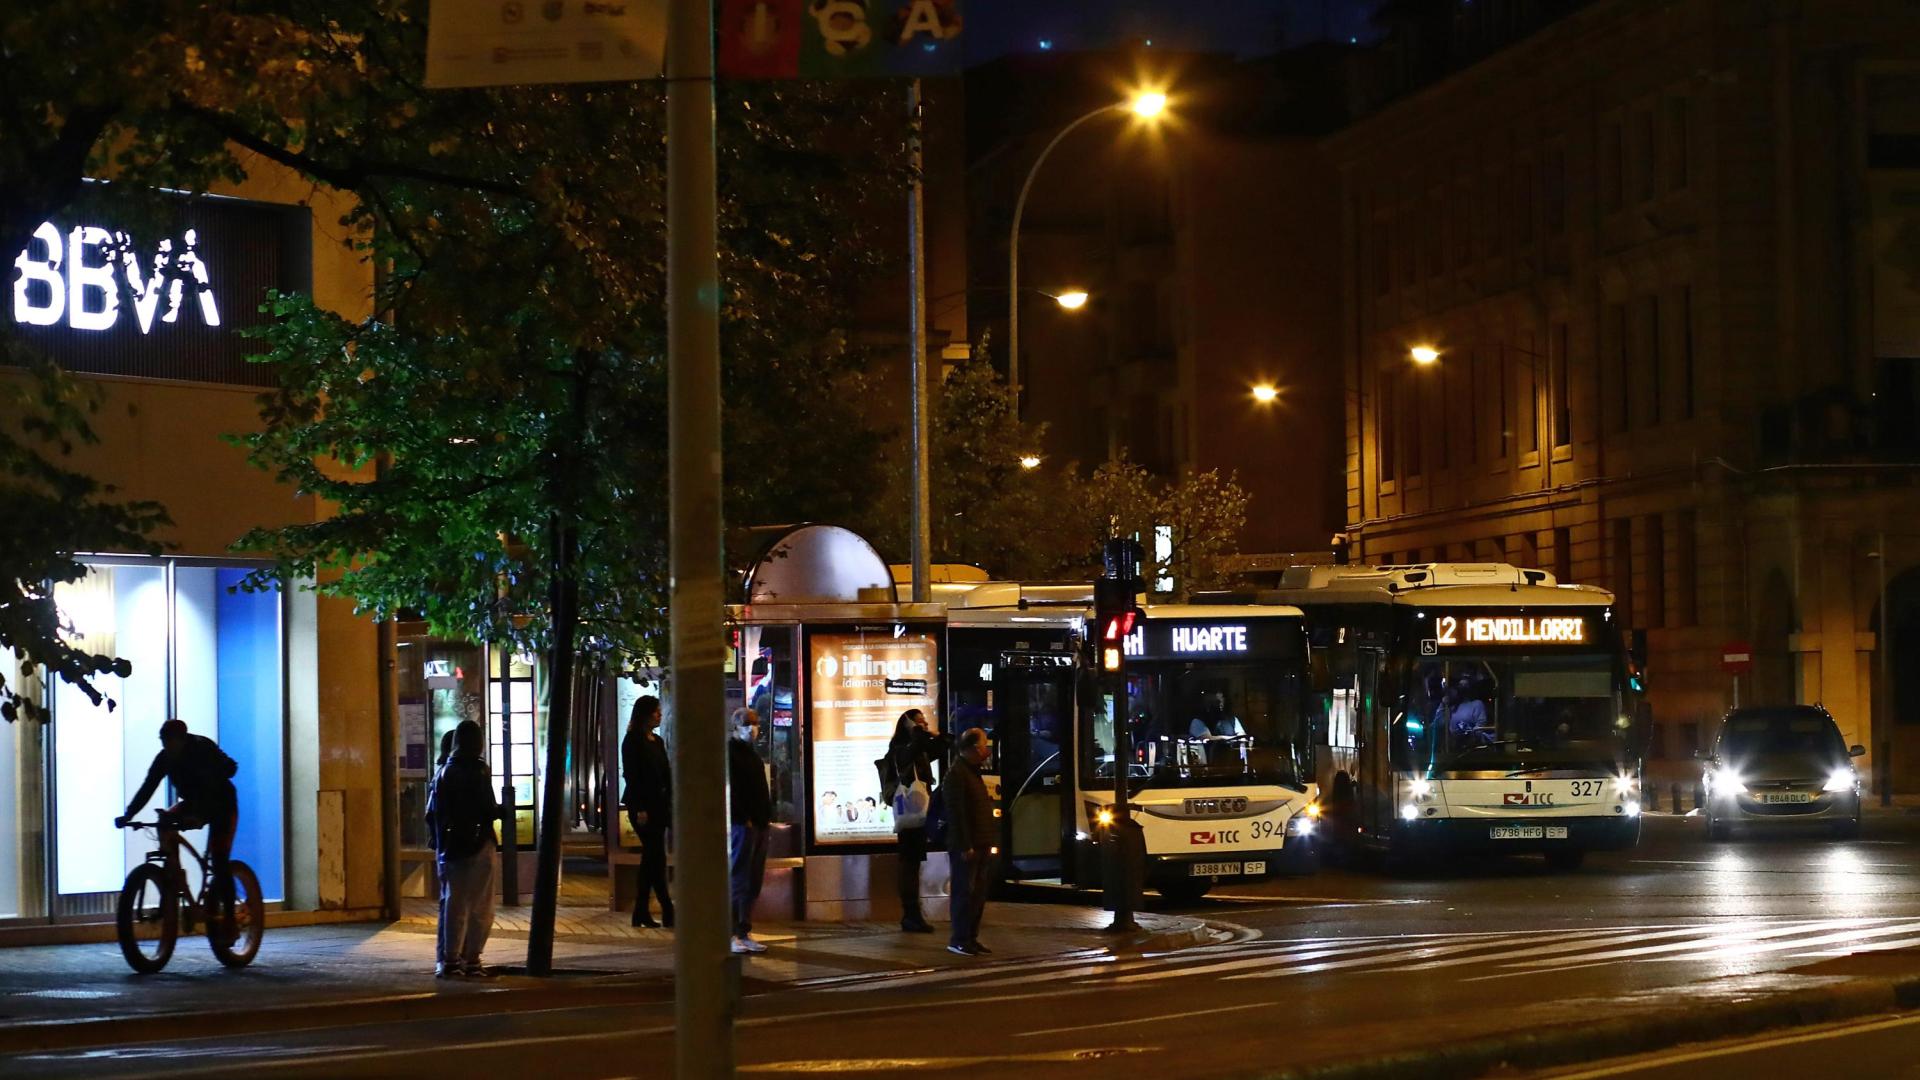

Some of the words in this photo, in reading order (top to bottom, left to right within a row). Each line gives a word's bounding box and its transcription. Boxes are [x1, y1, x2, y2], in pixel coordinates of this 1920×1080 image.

[14, 221, 220, 334] BBVA
[1466, 618, 1583, 641] MENDILLORRI
[1172, 626, 1247, 652] HUARTE
[842, 654, 928, 680] inlingua
[842, 677, 884, 688] idiomas
[1571, 781, 1603, 797] 327
[1184, 798, 1247, 814] IVECO
[1533, 793, 1554, 805] TCC
[1218, 830, 1240, 844] TCC
[1250, 820, 1285, 839] 394
[1247, 863, 1263, 873] SP
